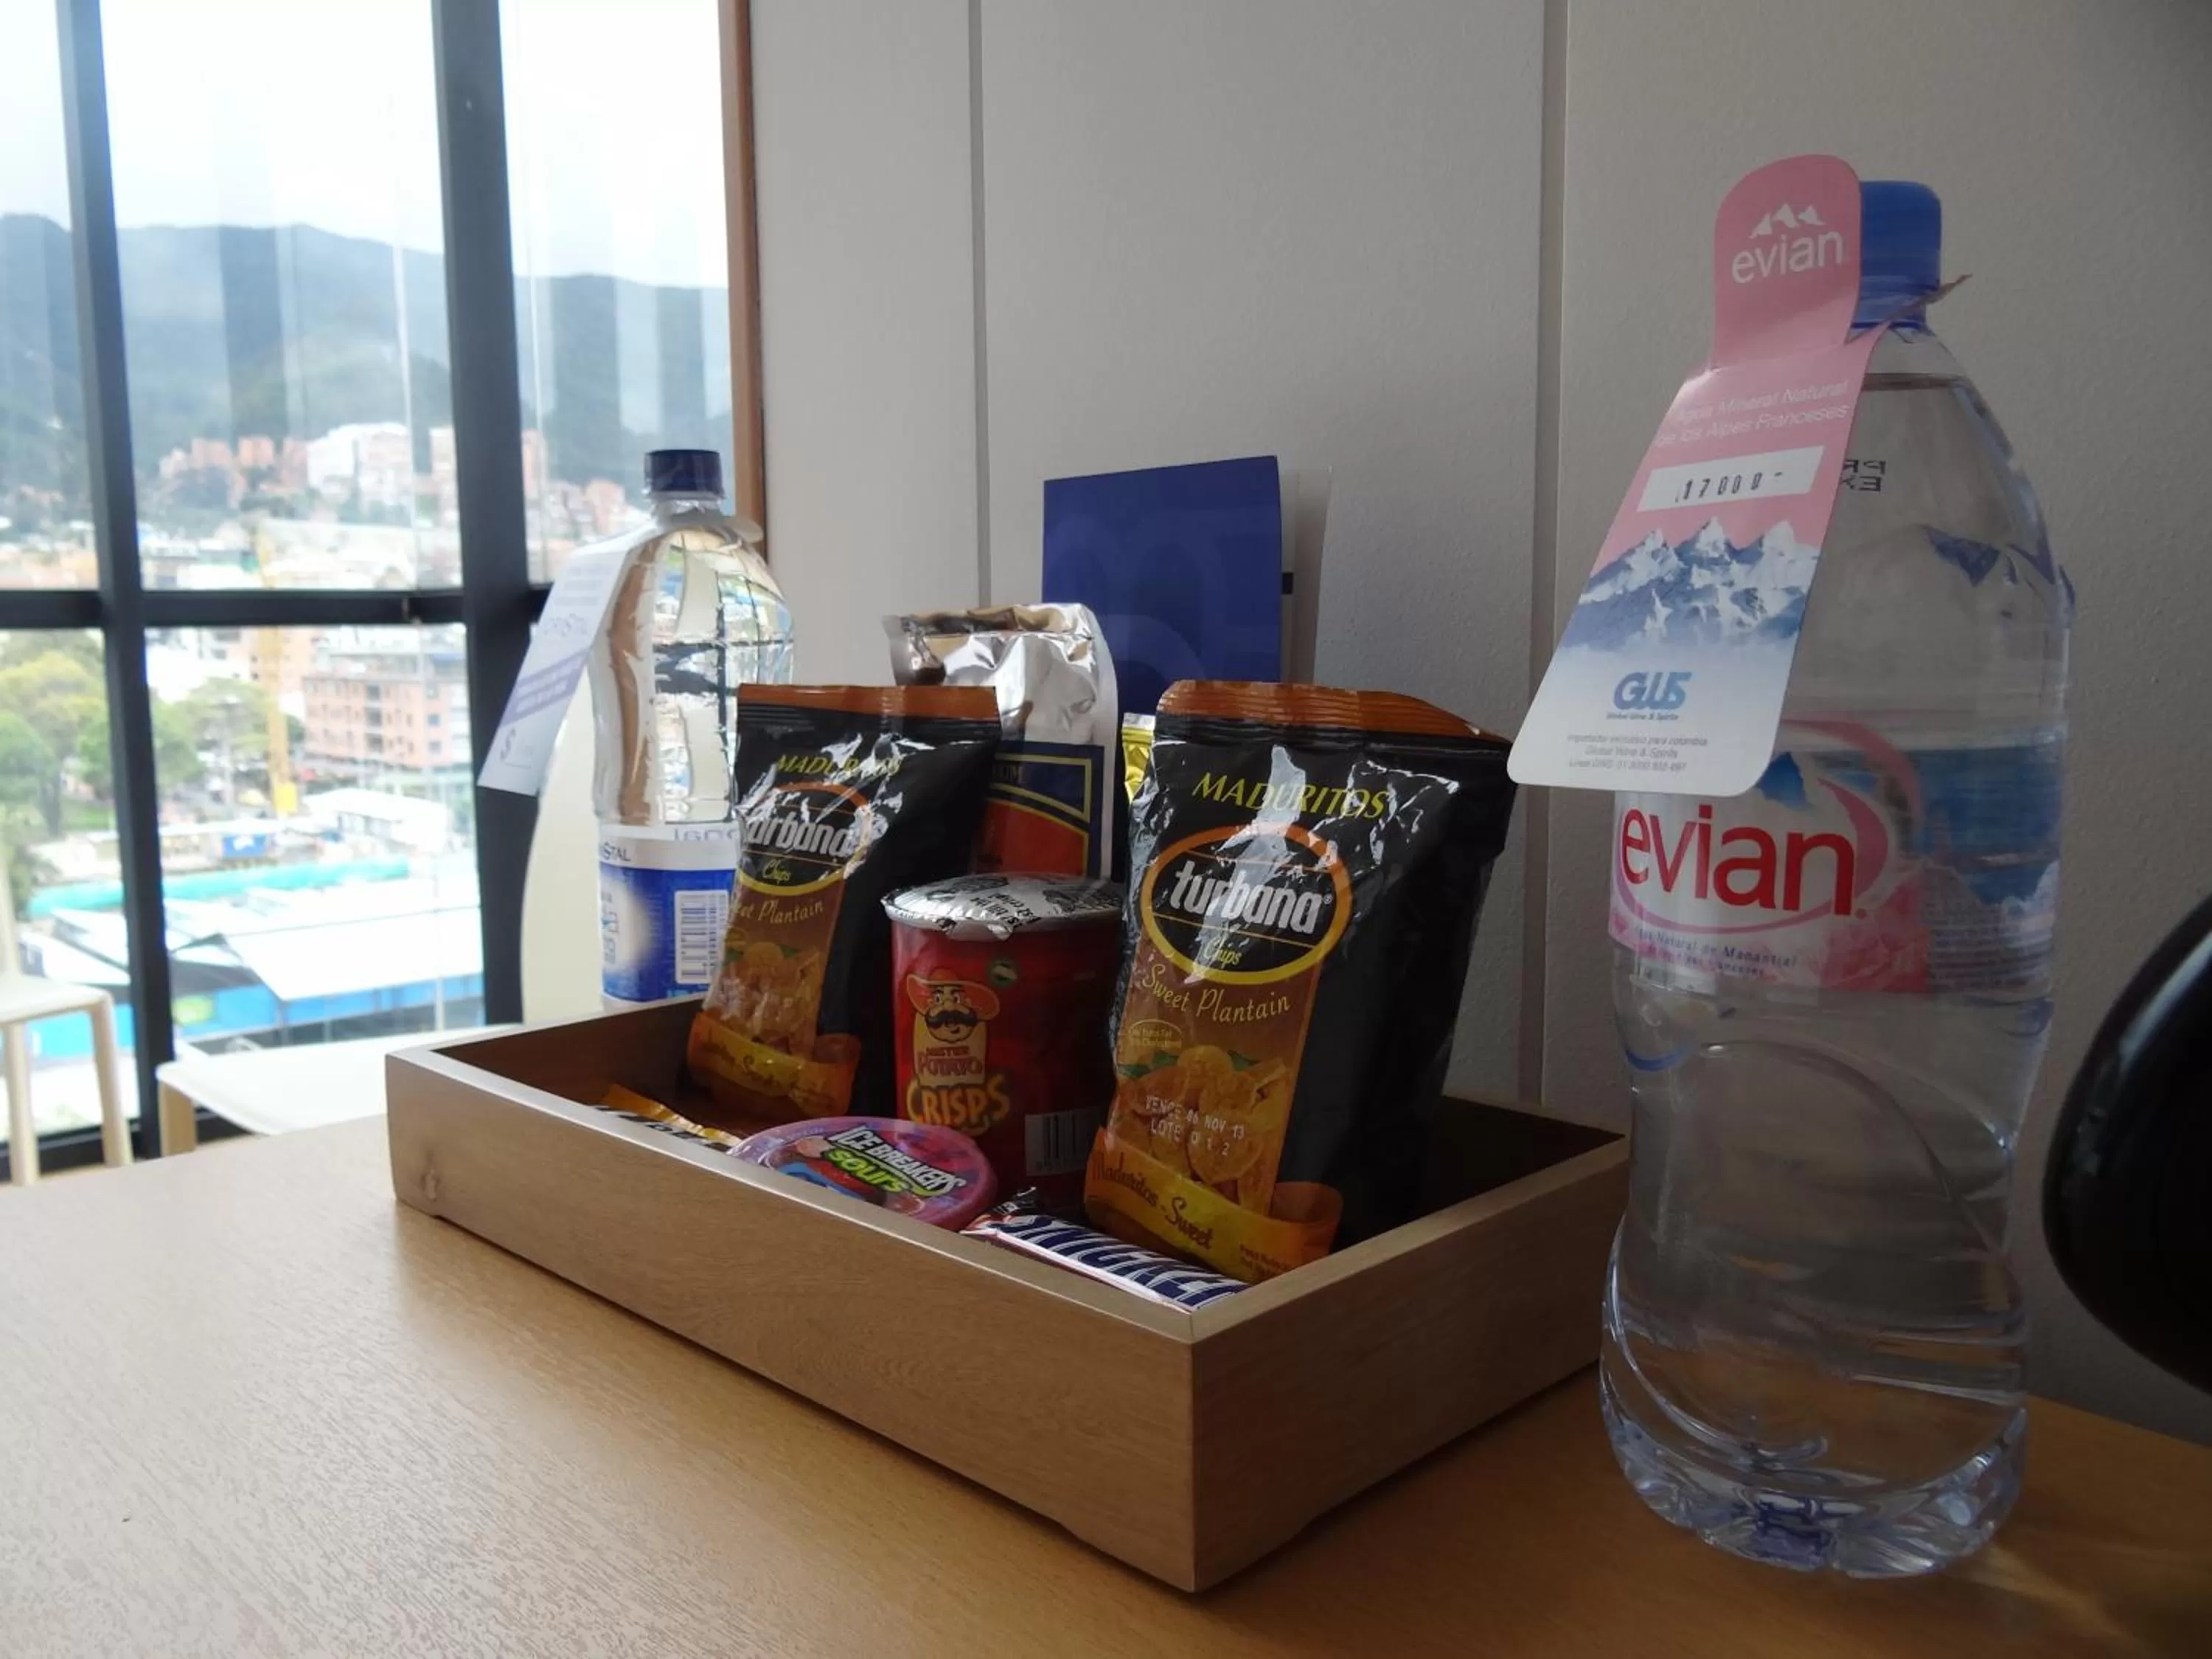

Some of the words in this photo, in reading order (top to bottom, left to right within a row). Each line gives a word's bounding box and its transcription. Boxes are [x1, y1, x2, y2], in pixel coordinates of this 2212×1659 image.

[1733, 231, 1843, 284] evian
[1782, 380, 1848, 403] Natural
[1191, 772, 1389, 818] MADURITOS
[1621, 804, 1855, 917] evian
[757, 898, 824, 924] Plantain
[1169, 860, 1324, 935] turbana
[1142, 963, 1190, 1013] Sweet
[1195, 988, 1291, 1023] Plantain
[906, 1073, 1011, 1127] CRISPS
[827, 1125, 876, 1152] ICE
[869, 1141, 967, 1190] BREAKERS
[1164, 1196, 1215, 1251] Sweet
